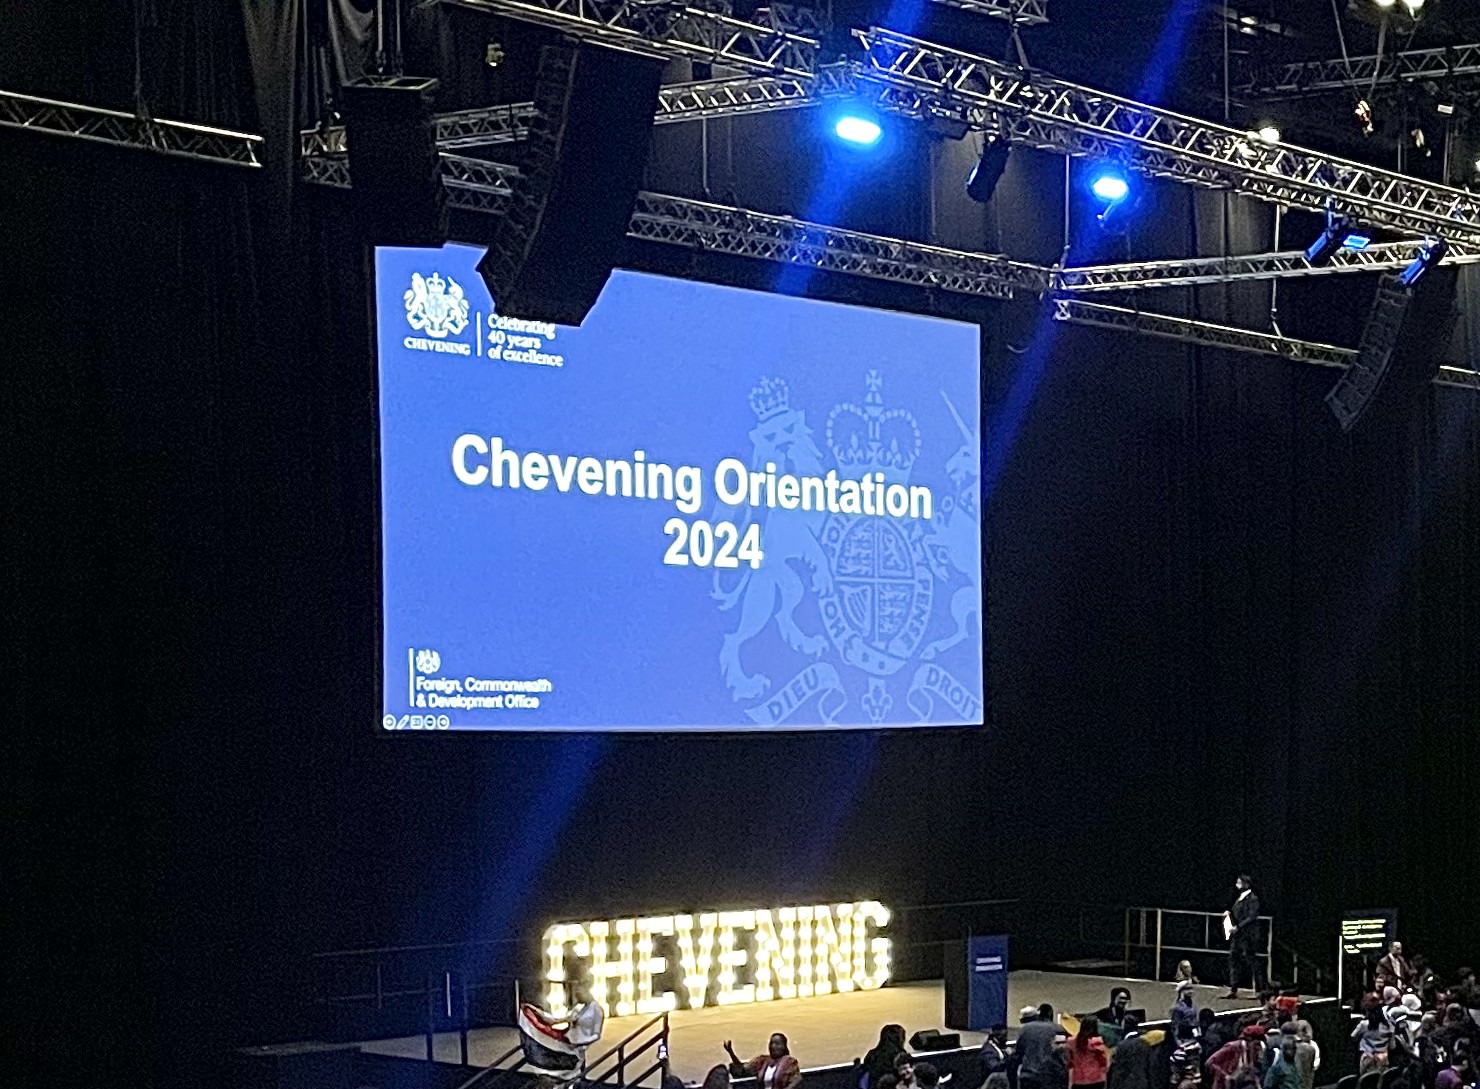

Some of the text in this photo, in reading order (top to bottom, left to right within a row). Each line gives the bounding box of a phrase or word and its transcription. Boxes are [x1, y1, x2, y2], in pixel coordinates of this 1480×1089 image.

[403, 337, 471, 355] CHEVENING
[488, 330, 541, 349] 40 years
[488, 345, 563, 367] of excellence
[451, 433, 934, 519] Chevening Orientation
[663, 517, 765, 568] 2024
[416, 676, 552, 694] Foreign, Commonwealth
[416, 693, 539, 710] & Development Office
[767, 667, 819, 721] DIEU
[926, 666, 981, 719] DROIT
[541, 900, 891, 1019] CHEVENING
